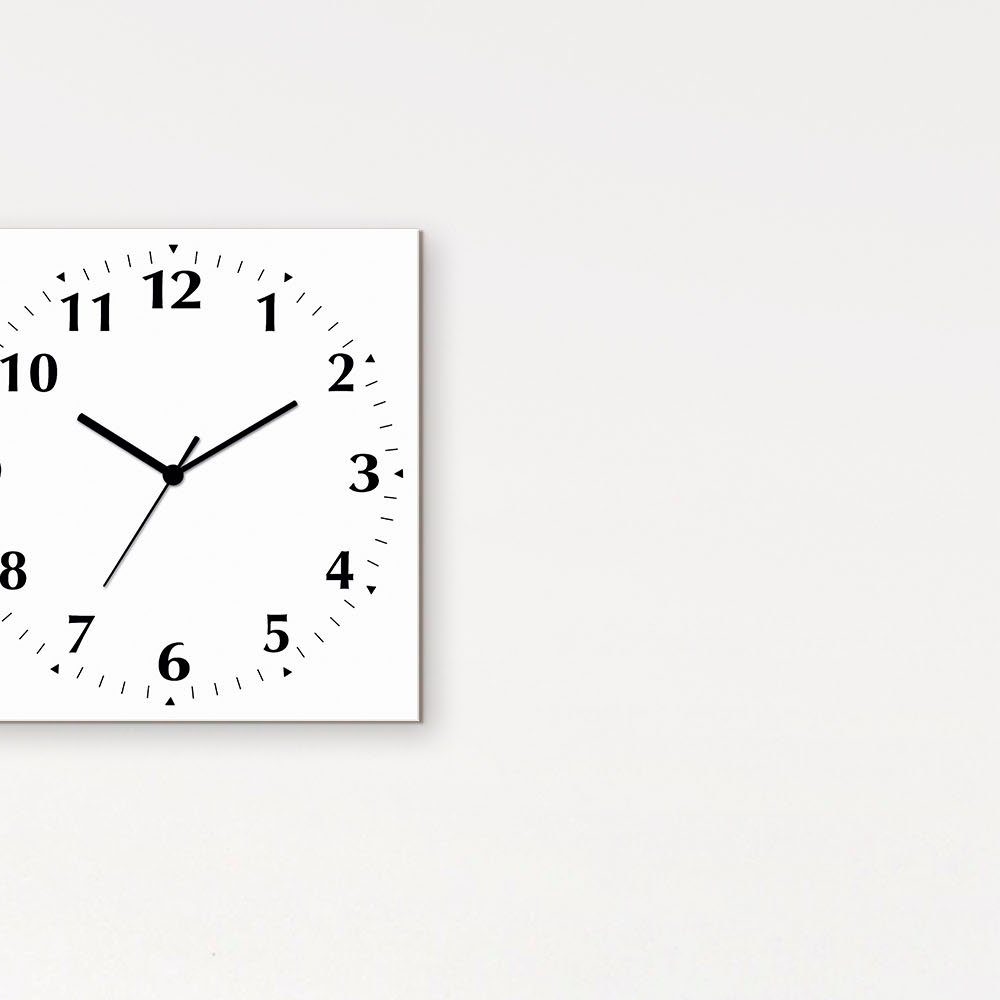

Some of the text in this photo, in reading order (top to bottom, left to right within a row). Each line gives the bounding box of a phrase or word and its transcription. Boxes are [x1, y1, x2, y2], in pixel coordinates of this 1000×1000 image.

[143, 270, 201, 309] 12
[61, 292, 110, 332] 11
[257, 292, 276, 332] 1
[0, 352, 58, 393] 10
[328, 352, 354, 392] 2
[348, 453, 380, 493] 3
[0, 550, 27, 591] 8
[325, 550, 354, 590] 4
[68, 614, 96, 654] 7
[263, 613, 290, 654] 5
[158, 641, 191, 682] 6
